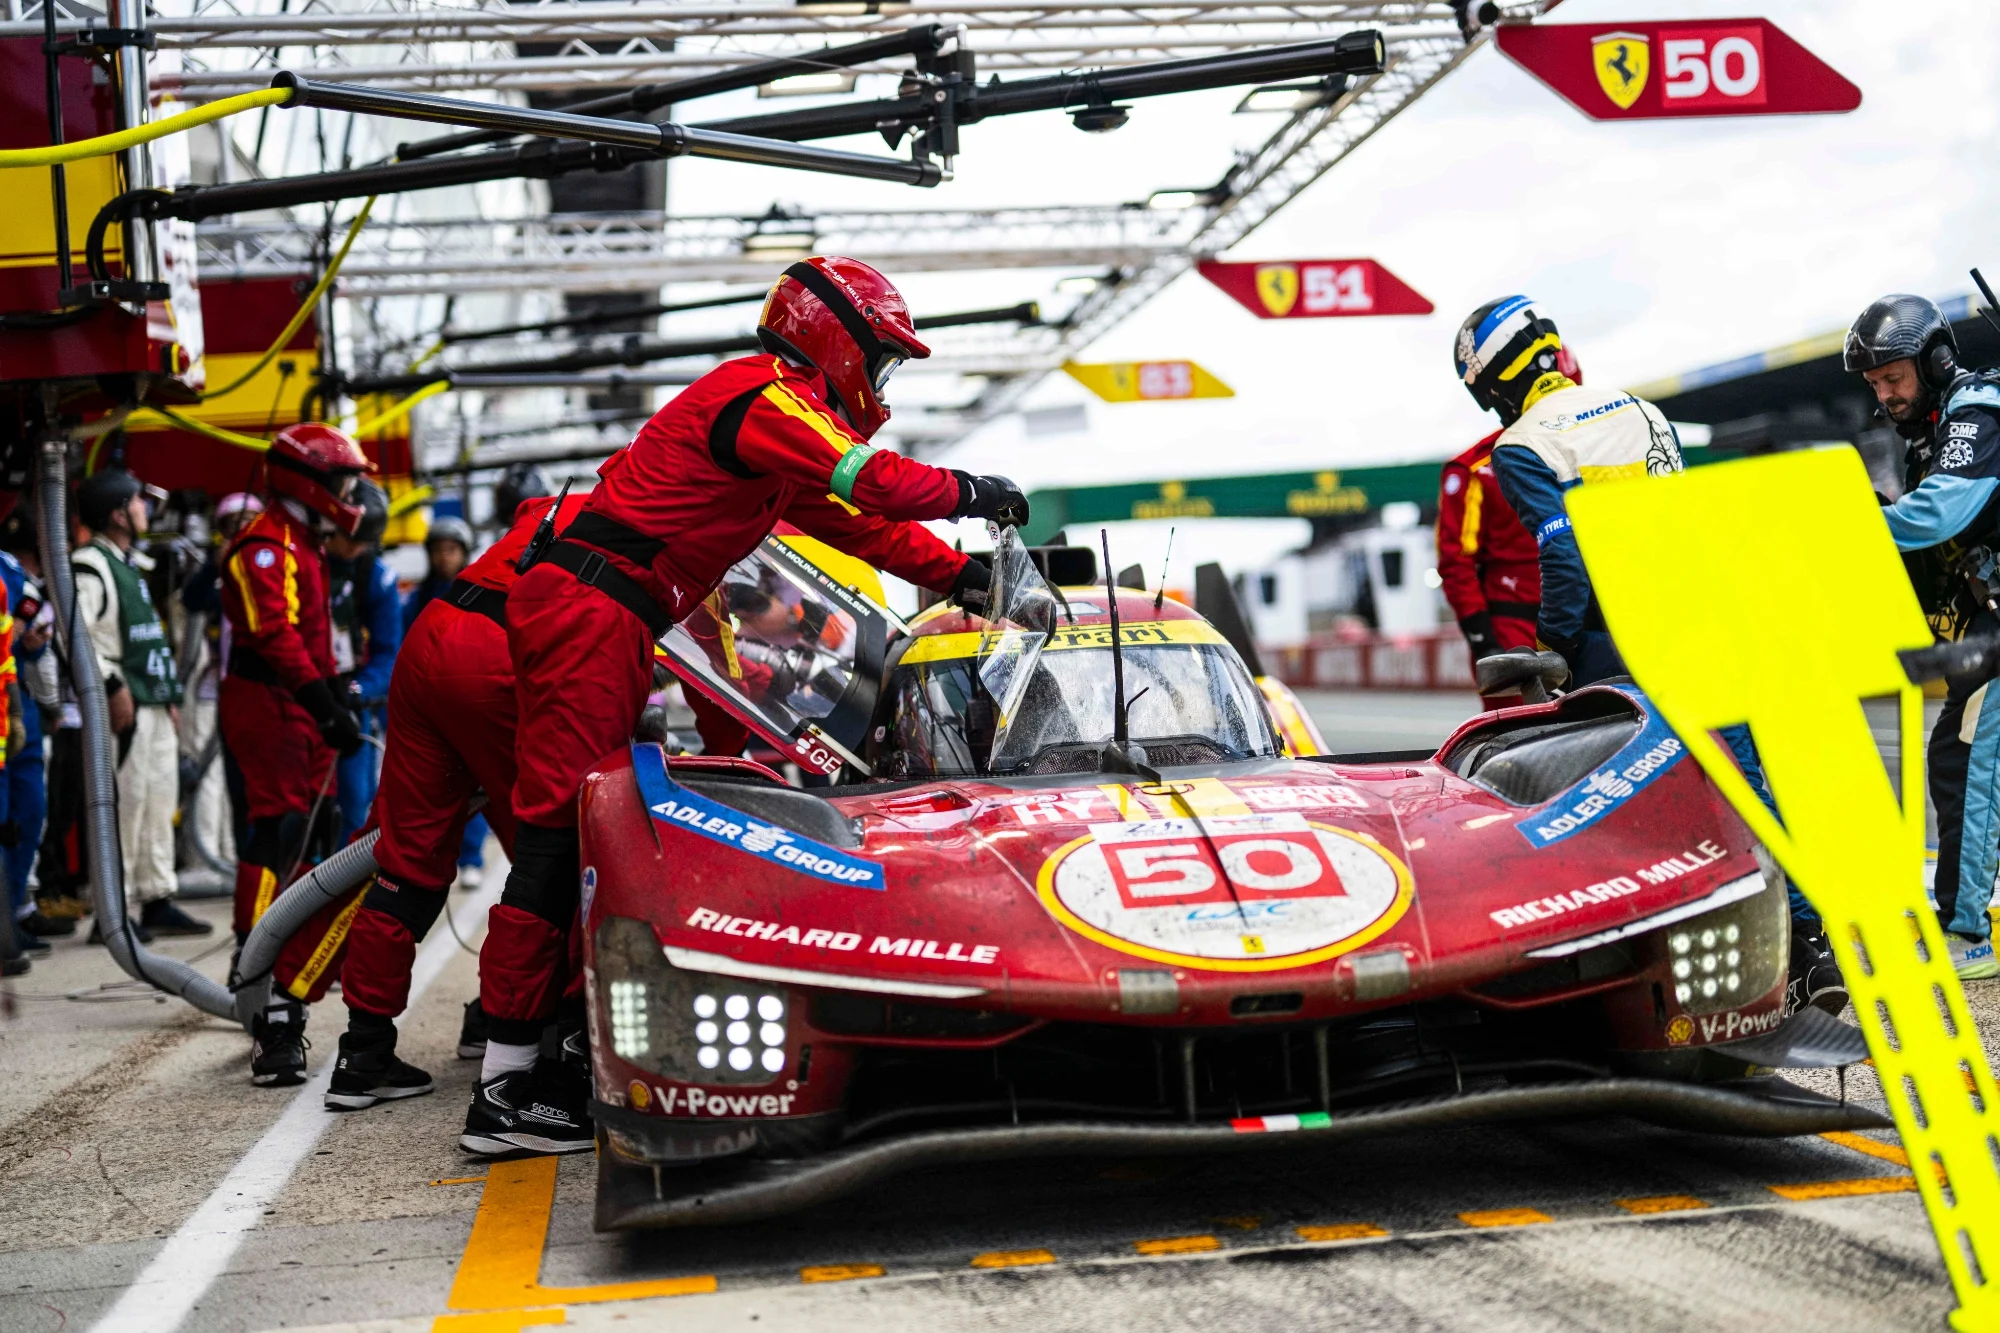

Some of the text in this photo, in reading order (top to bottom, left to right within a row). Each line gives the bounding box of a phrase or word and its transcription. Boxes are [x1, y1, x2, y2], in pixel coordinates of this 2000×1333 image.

[1663, 36, 1760, 99] 50
[1303, 265, 1373, 310] 51
[1949, 424, 1978, 437] OMP
[1544, 518, 1565, 535] TYRE
[776, 543, 818, 578] M. MOLINA
[827, 582, 871, 617] N. NIELSEN
[810, 748, 841, 774] GE
[1536, 737, 1682, 841] ADLER GROUP
[1012, 799, 1096, 825] HY
[651, 800, 874, 882] ADLER GROUP
[1116, 839, 1323, 899] 50
[1490, 839, 1728, 928] RICHARD MILLE
[686, 907, 1001, 964] RICHARD MILLE
[1700, 1007, 1783, 1042] V-Power
[531, 1102, 570, 1119] sparco
[655, 1086, 796, 1116] V-Power
